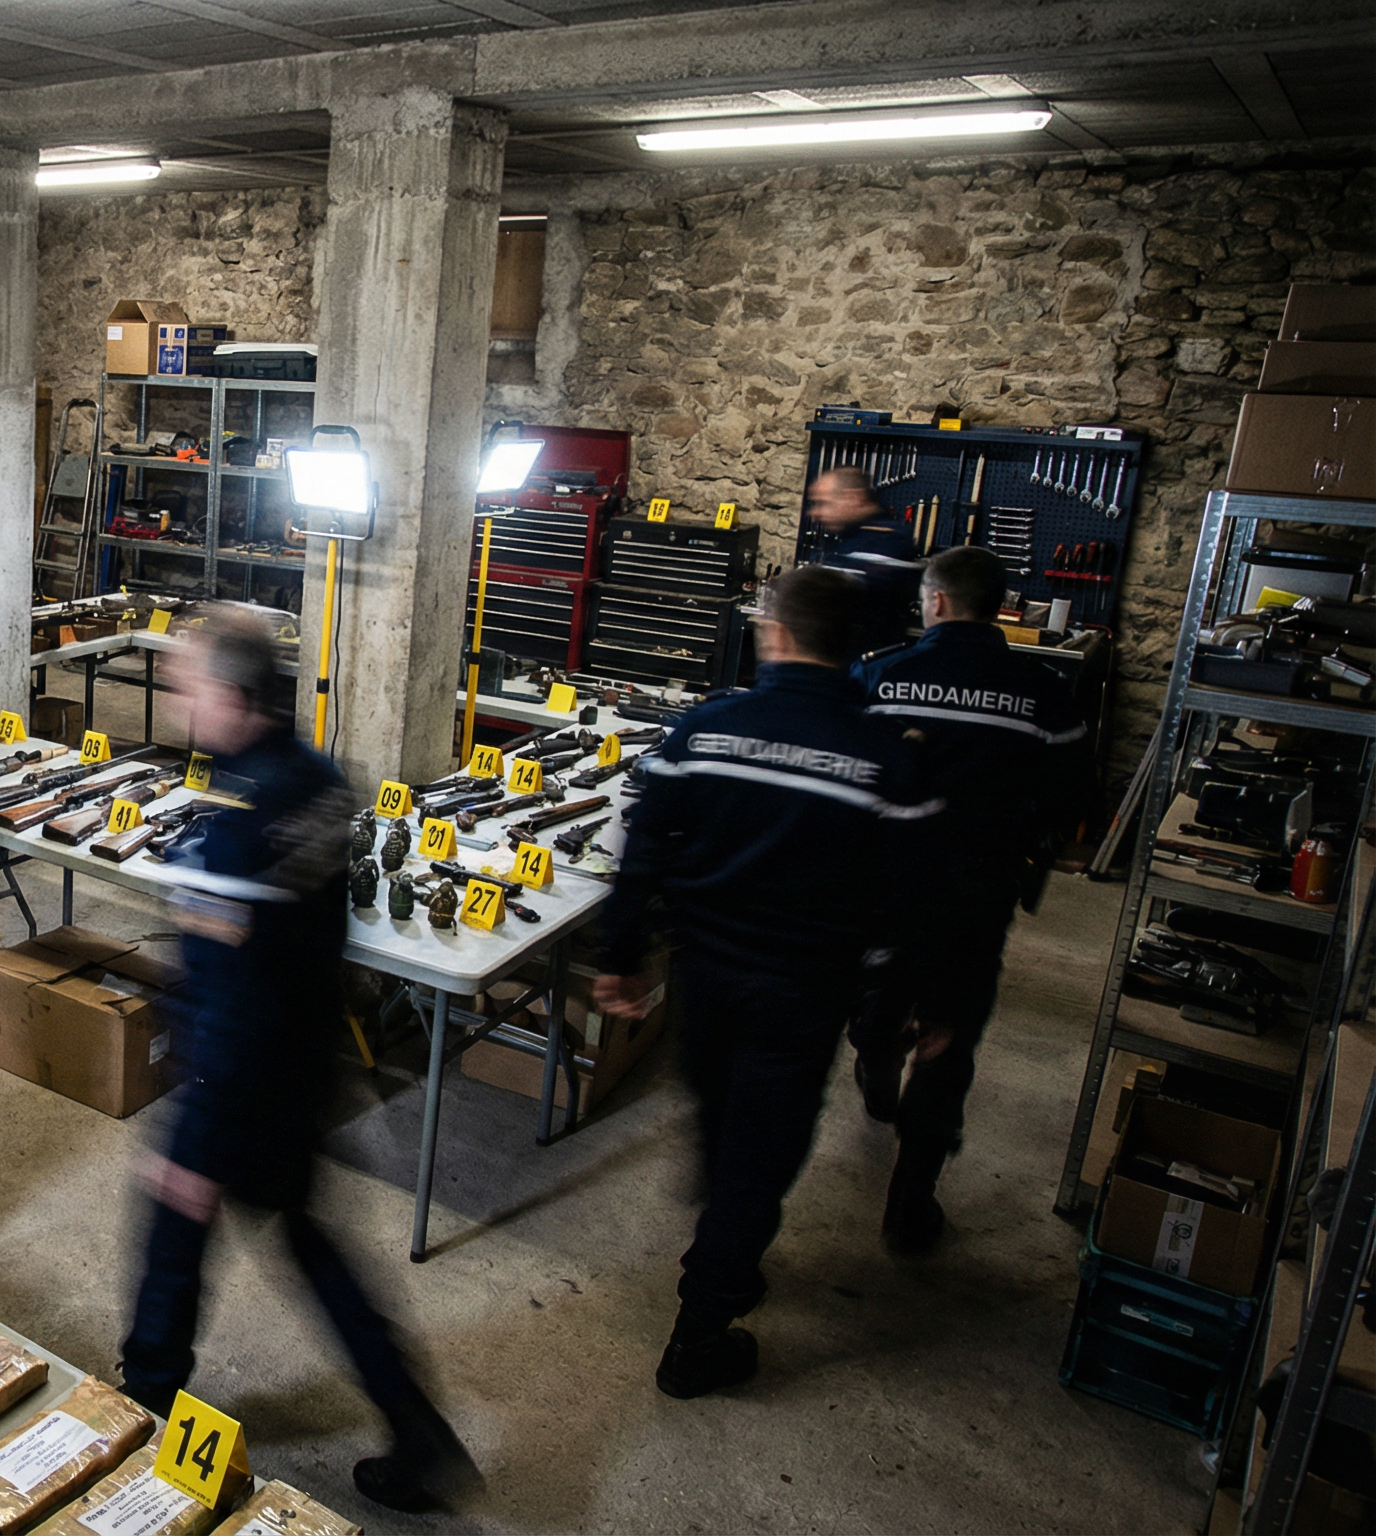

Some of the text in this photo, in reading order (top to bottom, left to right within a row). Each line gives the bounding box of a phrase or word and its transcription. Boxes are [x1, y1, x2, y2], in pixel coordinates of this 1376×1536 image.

[877, 682, 1037, 717] GENDAMERIE
[516, 765, 535, 788] 14
[381, 786, 402, 810] 09
[521, 850, 543, 878] 14
[467, 886, 497, 916] 27
[174, 1415, 222, 1483] 14
